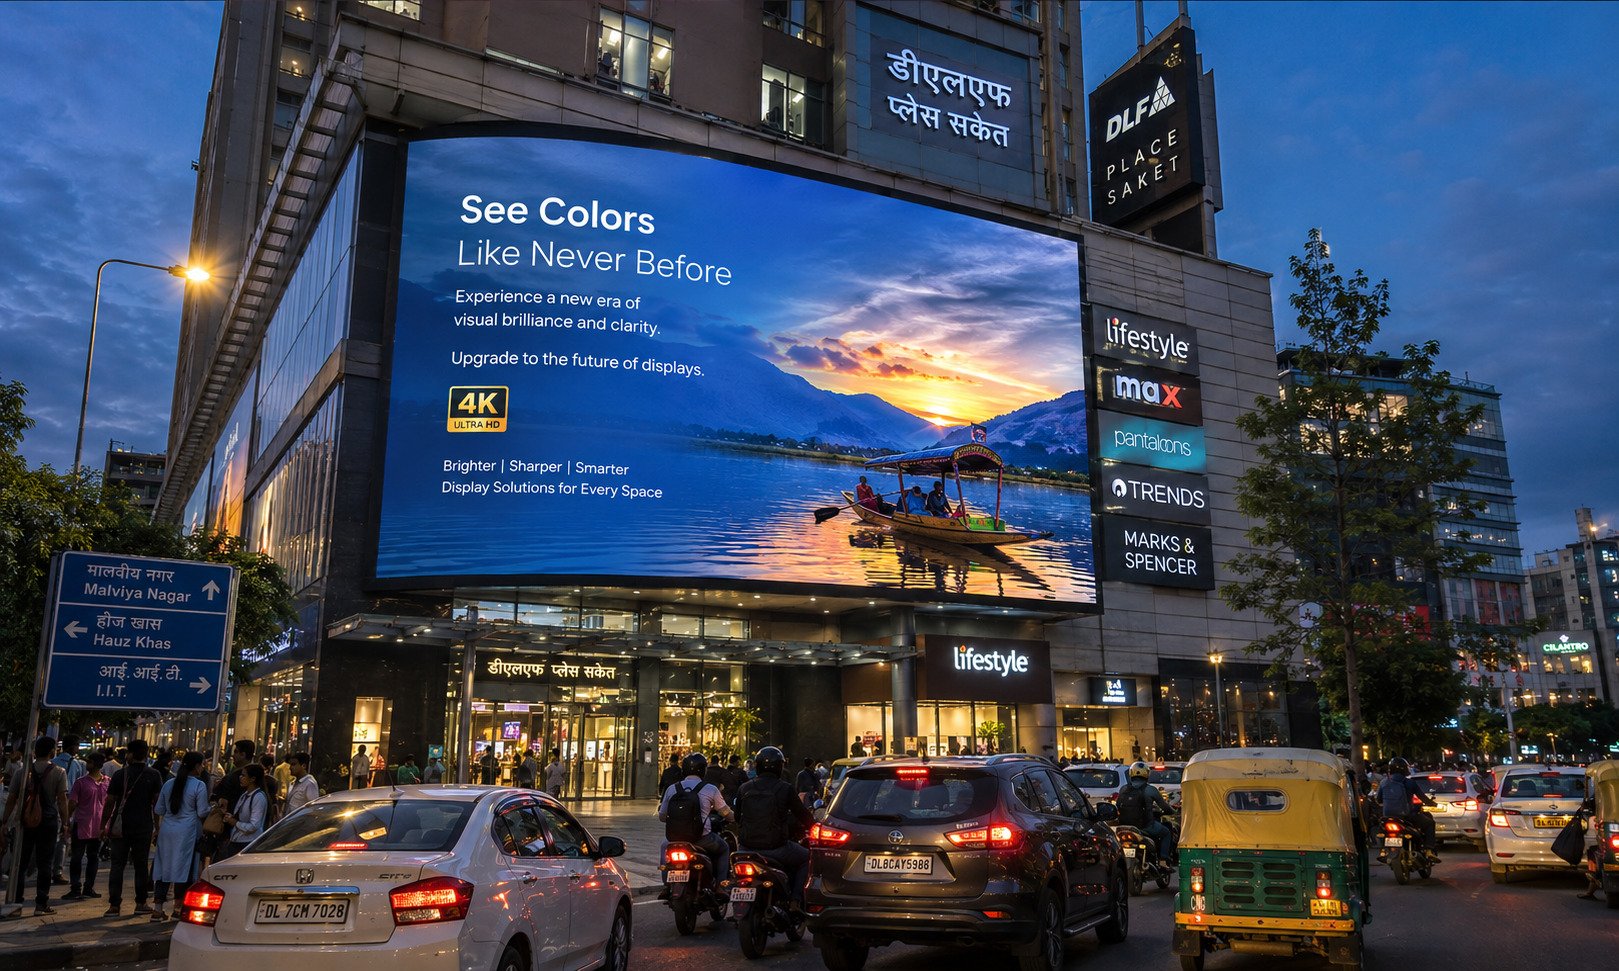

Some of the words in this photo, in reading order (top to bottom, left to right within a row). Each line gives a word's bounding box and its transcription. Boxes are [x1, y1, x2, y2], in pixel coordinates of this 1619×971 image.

[886, 48, 1012, 108] डीएलएफ
[887, 93, 941, 130] प्लेस
[947, 111, 1010, 148] सकेत
[1106, 95, 1150, 143] DLF
[1107, 129, 1178, 181] PLACE
[1107, 155, 1178, 205] SAKET
[460, 194, 529, 224] See
[539, 197, 655, 235] Colors
[458, 239, 520, 266] Like
[532, 240, 626, 271] Never
[636, 249, 732, 286] Before
[455, 289, 543, 306] Experience
[546, 292, 556, 304] a
[560, 292, 593, 306] new
[597, 296, 621, 309] era
[625, 297, 641, 310] of
[454, 313, 498, 327] visual
[502, 313, 573, 329] brilliance
[577, 317, 607, 331] and
[610, 319, 661, 338] clarity.
[1106, 317, 1190, 360] lifestyle
[451, 351, 519, 368] Upgrade
[522, 352, 539, 366] to
[542, 352, 569, 367] the
[572, 353, 620, 369] future
[623, 356, 639, 371] of
[641, 358, 705, 378] displays.
[458, 392, 498, 414] 4K
[1115, 374, 1183, 409] max
[454, 420, 484, 429] ULTRA
[486, 420, 500, 429] HD
[1114, 430, 1192, 457] pantaloons
[443, 459, 497, 475] Brighter
[509, 459, 563, 475] Sharper
[575, 461, 630, 476] Smarter
[441, 481, 491, 496] Display
[493, 481, 555, 495] Solutions
[558, 482, 578, 495] for
[580, 482, 618, 499] Every
[621, 484, 664, 500] Space
[1127, 480, 1205, 509] TRENDS
[1124, 530, 1181, 552] MARKS
[1184, 538, 1195, 554] &
[87, 563, 142, 580] मालवीय
[146, 569, 175, 583] नगर
[1125, 552, 1197, 576] SPENCER
[84, 583, 143, 601] Malviya
[147, 588, 191, 604] Nagar
[131, 617, 163, 630] खास
[94, 633, 131, 648] Hauz
[136, 636, 172, 650] Khas
[487, 658, 545, 678] डीएलएफ
[551, 661, 580, 678] प्लेस
[584, 662, 616, 679] सकेत
[954, 645, 1029, 677] lifestyle
[96, 684, 126, 697] I.I.T.
[265, 904, 280, 918] DL
[312, 904, 344, 918] 7028
